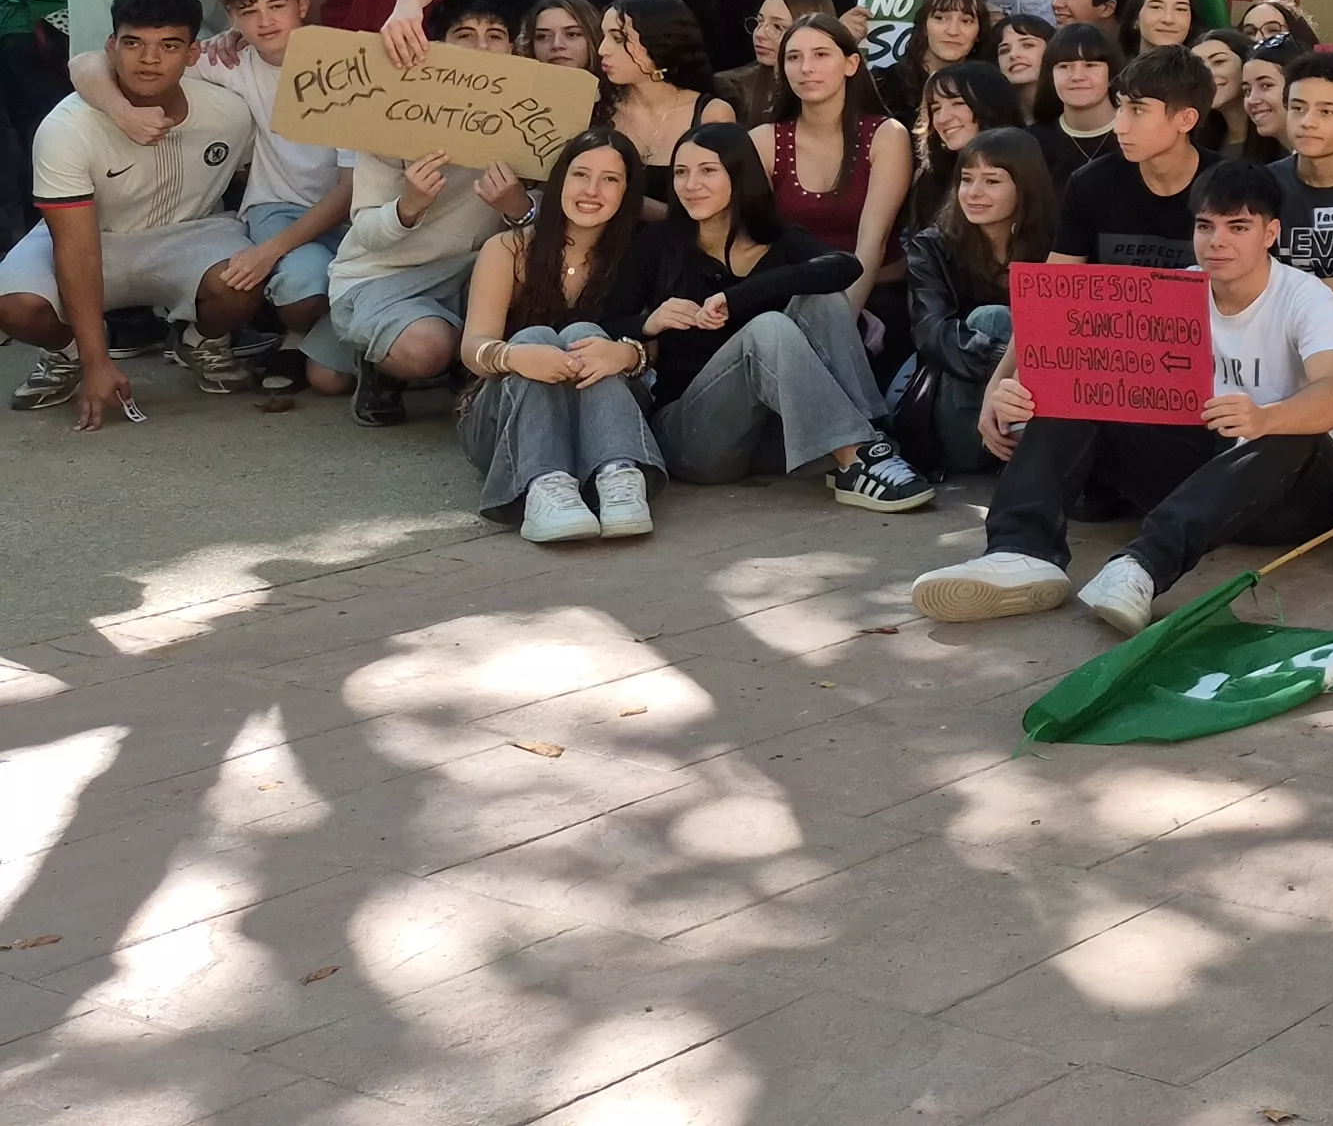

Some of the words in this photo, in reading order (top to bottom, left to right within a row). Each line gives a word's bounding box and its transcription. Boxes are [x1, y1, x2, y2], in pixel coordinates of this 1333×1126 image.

[400, 66, 508, 95] ESTAMOS
[1113, 243, 1185, 261] PERFECT
[1018, 273, 1153, 304] PROFESOR
[1067, 309, 1201, 345] SANCIONADO
[1024, 344, 1155, 374] ALUMNADO
